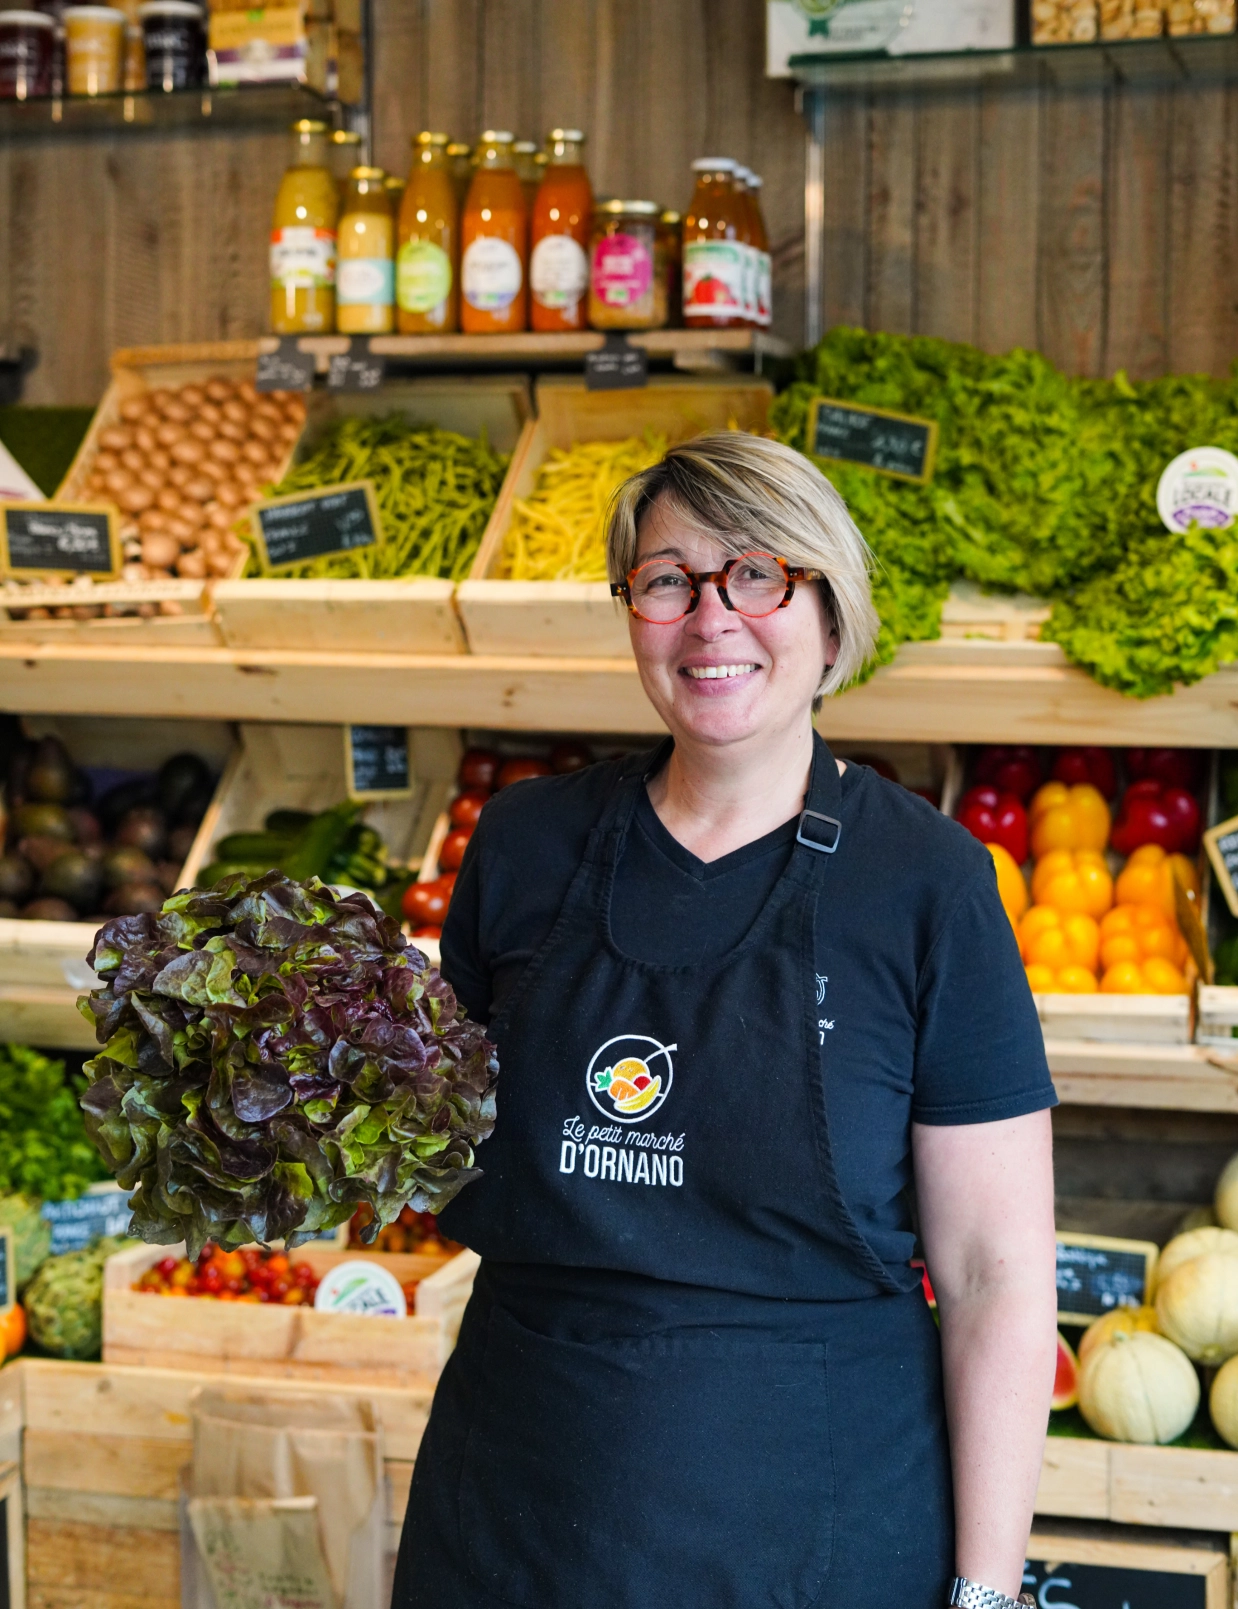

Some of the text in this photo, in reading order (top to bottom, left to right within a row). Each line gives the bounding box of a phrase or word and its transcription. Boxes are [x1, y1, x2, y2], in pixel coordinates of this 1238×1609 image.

[562, 1115, 686, 1152] Le petit marché
[559, 1140, 684, 1187] D'ORNANO
